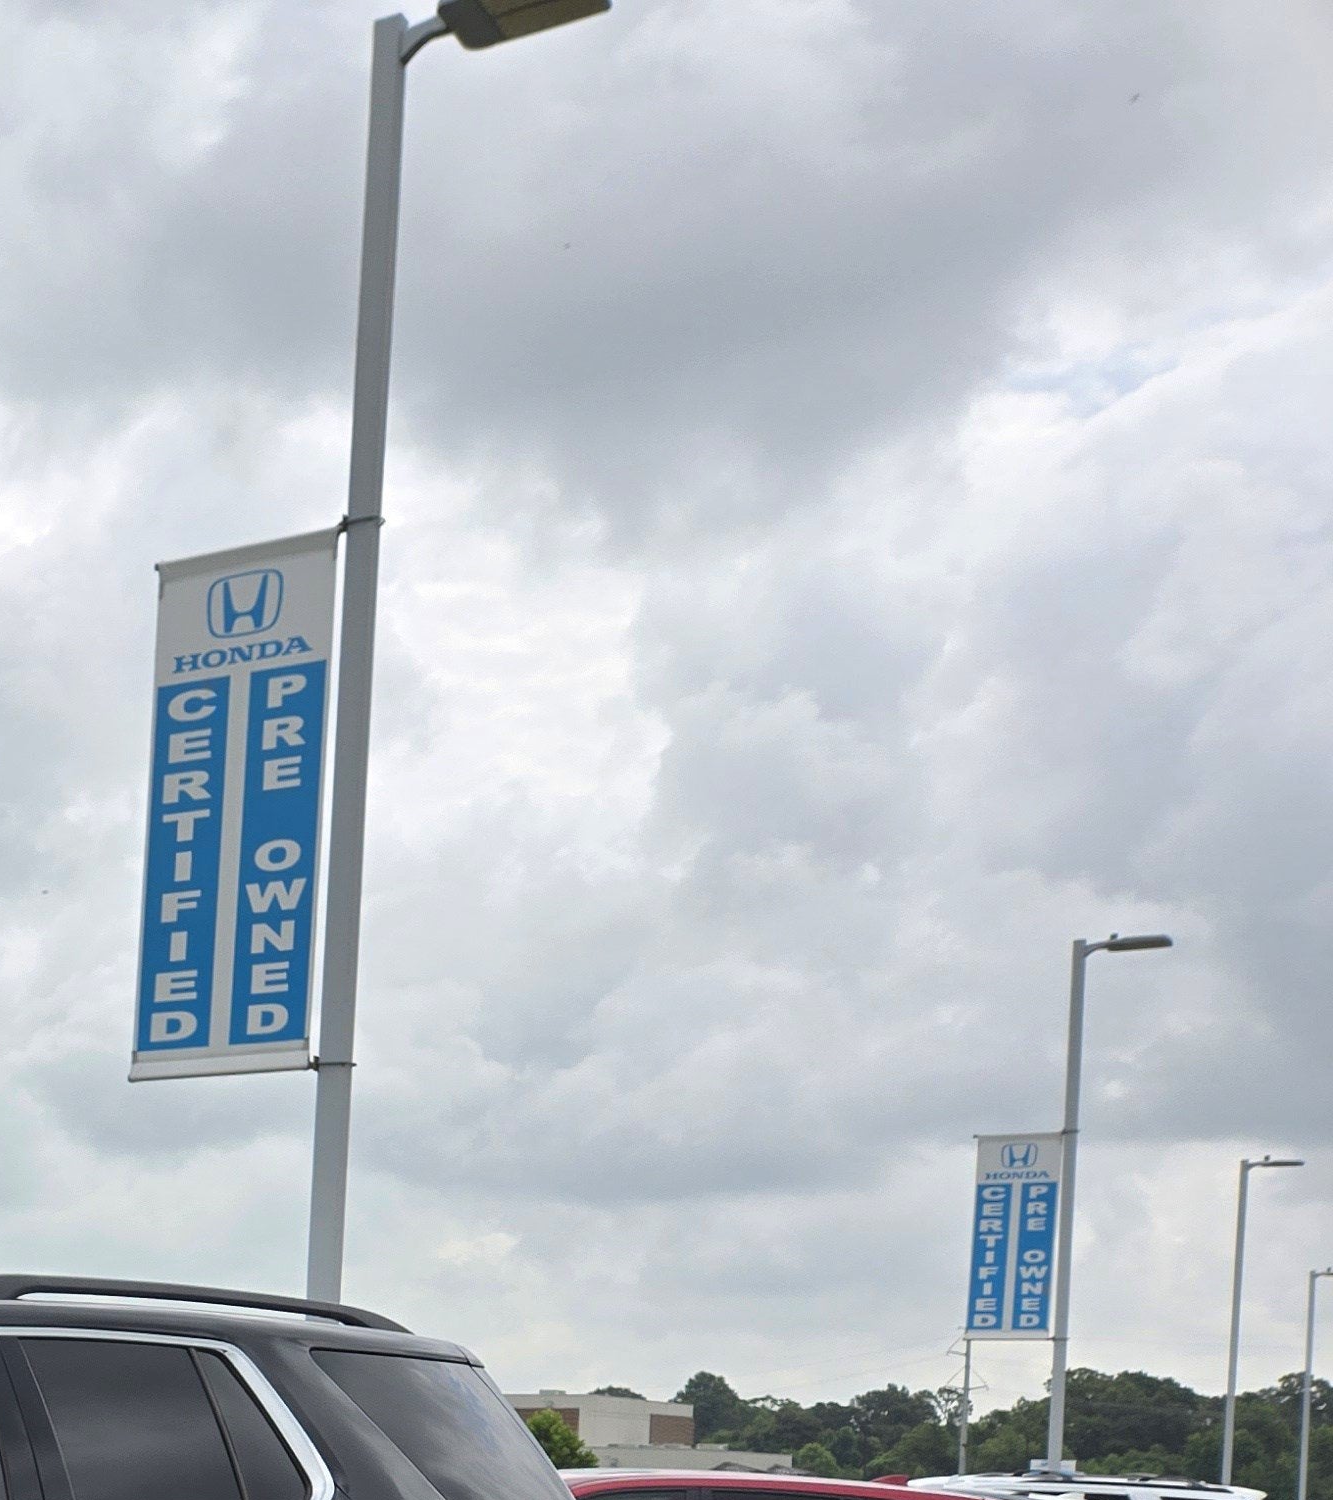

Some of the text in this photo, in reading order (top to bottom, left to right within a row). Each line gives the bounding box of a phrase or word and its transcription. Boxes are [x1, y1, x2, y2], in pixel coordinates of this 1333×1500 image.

[172, 636, 314, 674] HONDA
[148, 687, 218, 1044] CERTIFIED
[244, 672, 308, 1037] PRE OWNED
[985, 1169, 1050, 1181] HONDA
[972, 1185, 1007, 1329] CERTIFIED
[1018, 1184, 1049, 1329] PRE OWNED
